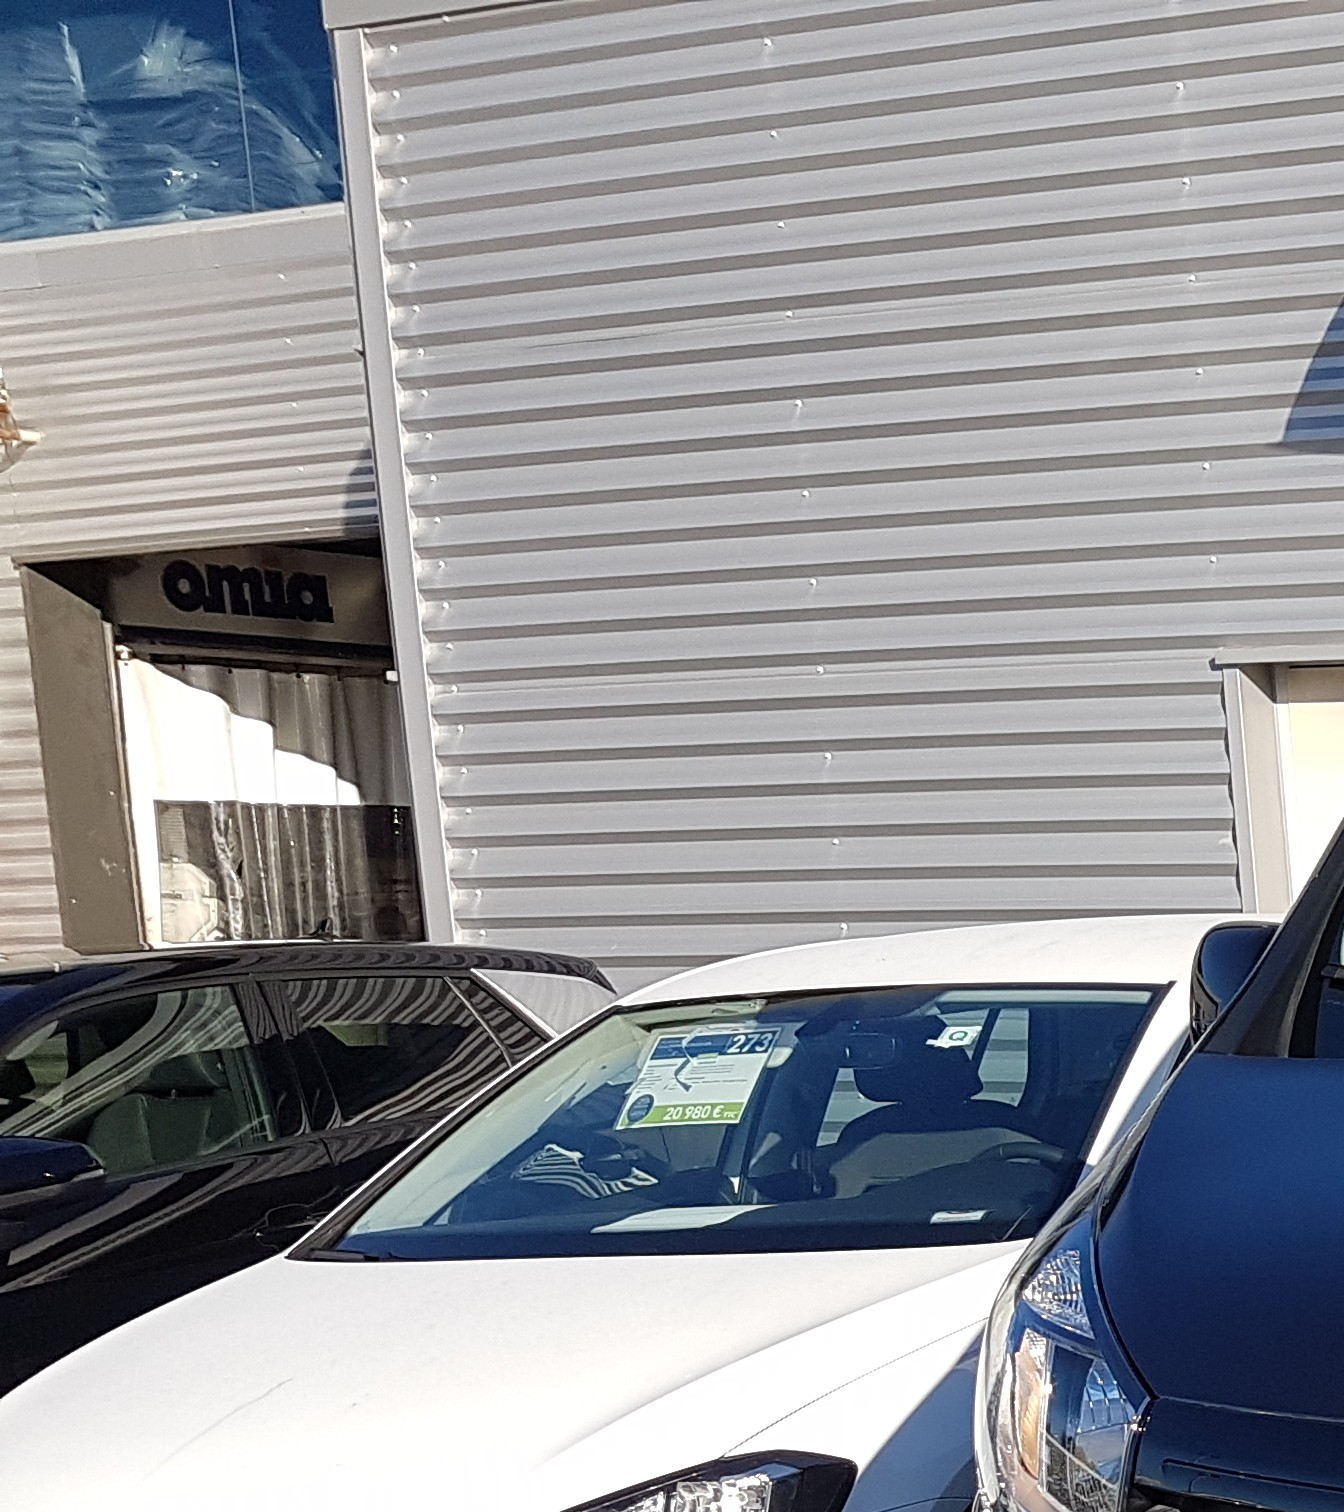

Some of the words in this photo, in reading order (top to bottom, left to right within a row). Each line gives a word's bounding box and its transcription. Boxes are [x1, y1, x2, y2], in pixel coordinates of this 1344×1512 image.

[727, 1032, 774, 1054] 273
[663, 1106, 683, 1121] 20
[684, 1105, 711, 1120] 980
